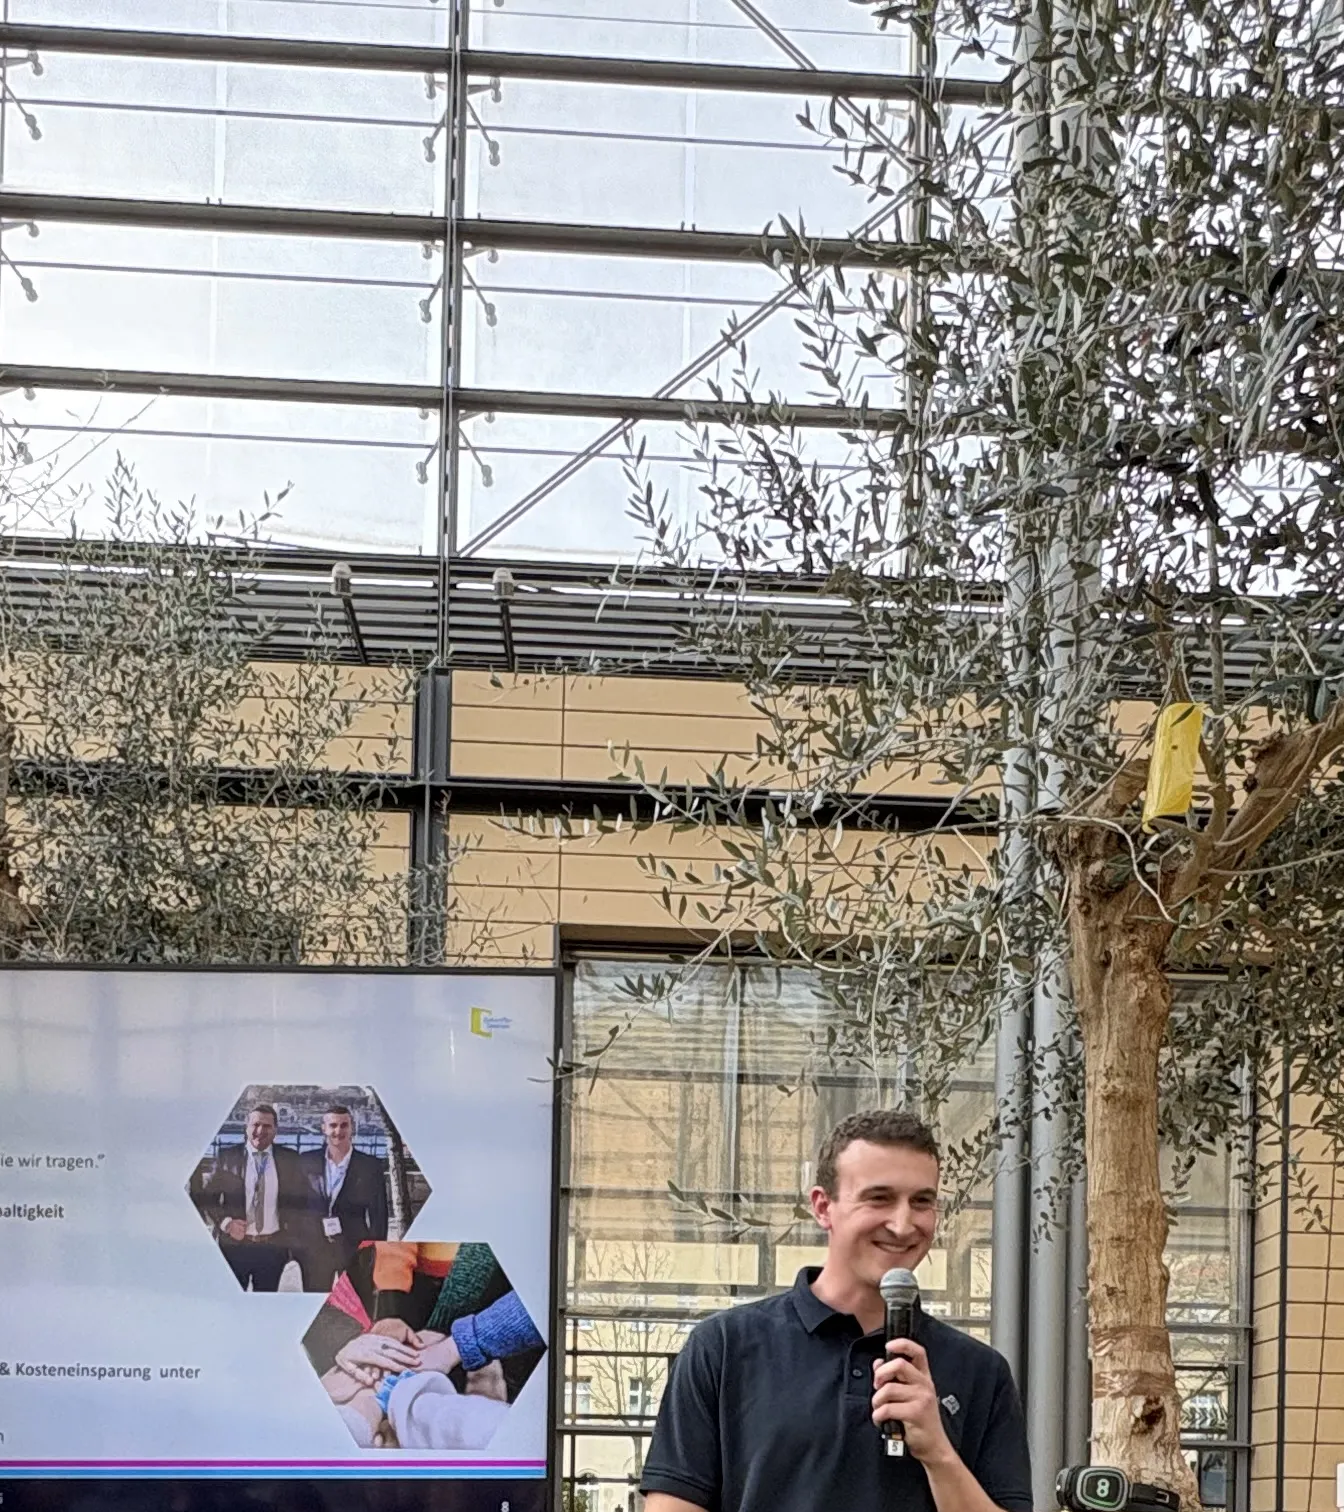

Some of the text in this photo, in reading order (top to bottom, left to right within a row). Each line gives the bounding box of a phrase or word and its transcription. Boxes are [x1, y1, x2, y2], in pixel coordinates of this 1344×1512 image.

[18, 1154, 42, 1168] wir
[15, 1362, 152, 1381] Kosteneinsparung
[159, 1366, 201, 1379] unter
